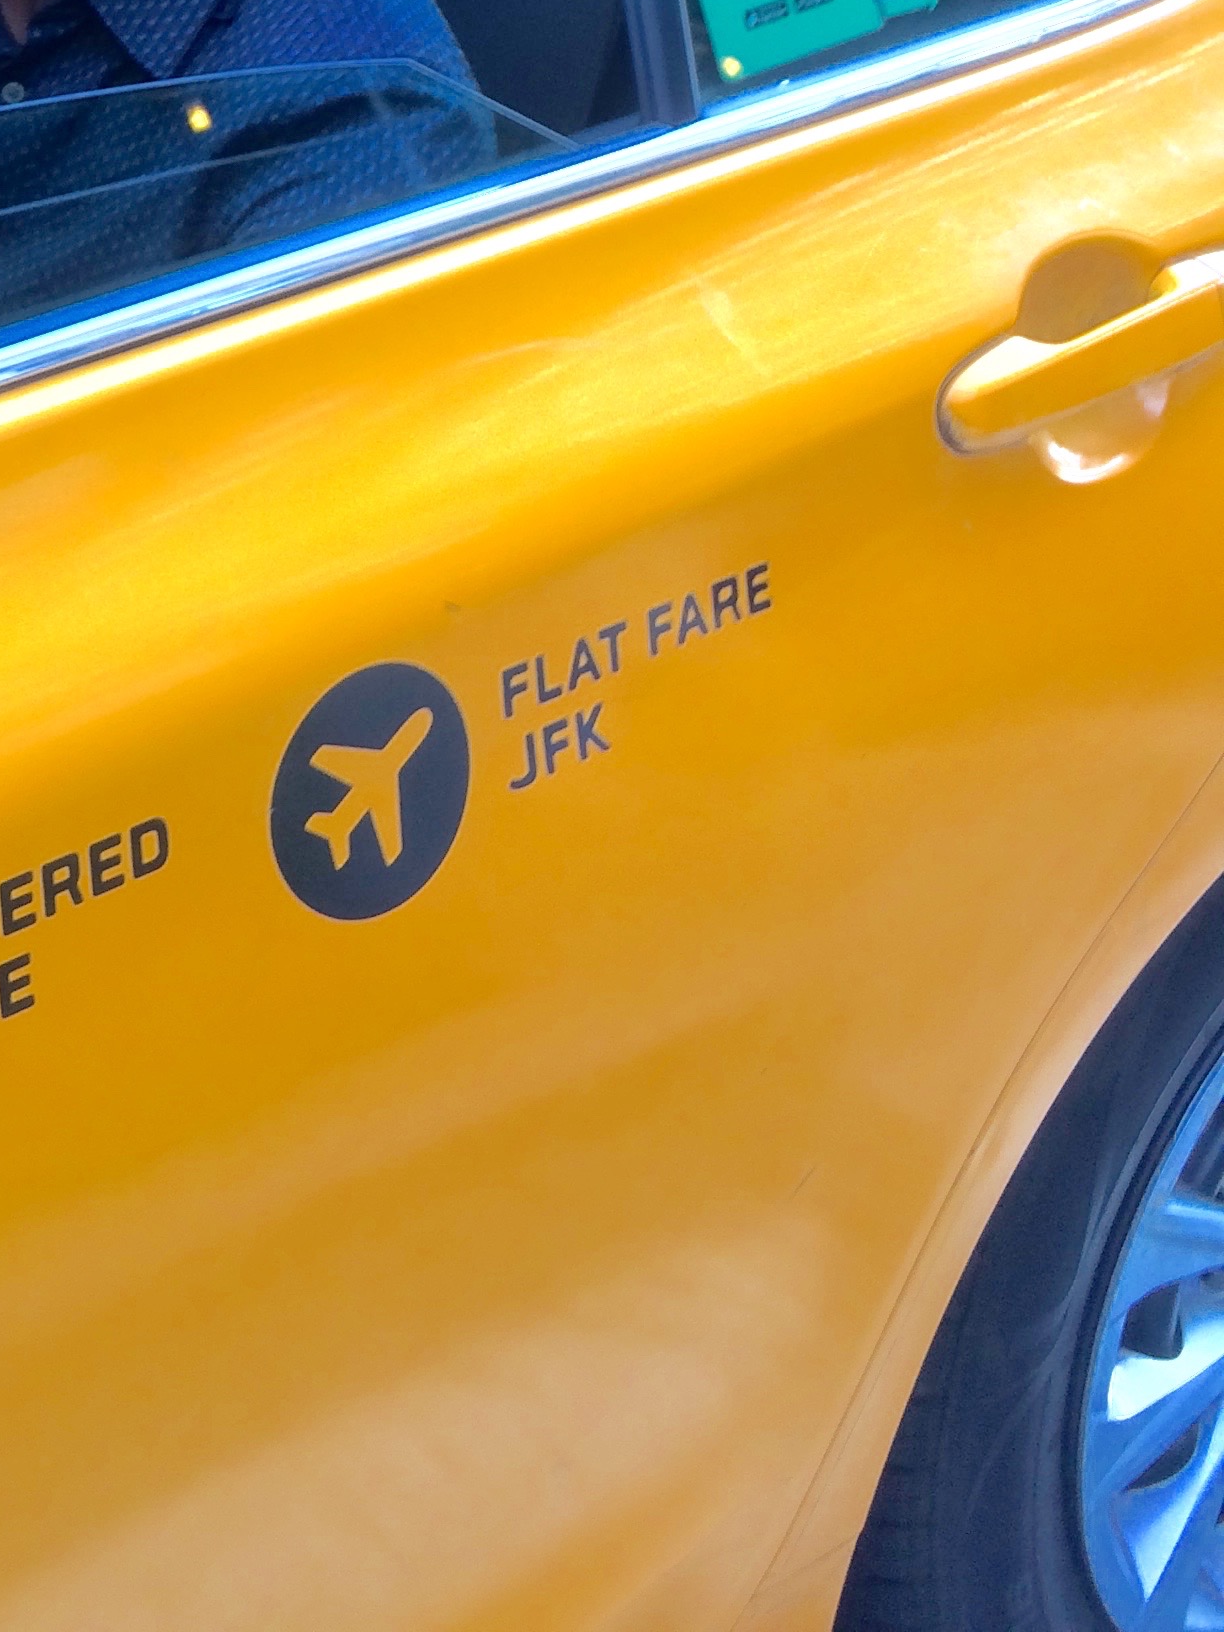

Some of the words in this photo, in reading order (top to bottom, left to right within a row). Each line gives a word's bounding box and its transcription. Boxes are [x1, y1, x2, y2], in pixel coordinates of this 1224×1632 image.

[502, 621, 627, 718] FLAT
[647, 563, 772, 656] FARE
[510, 702, 610, 791] JFK
